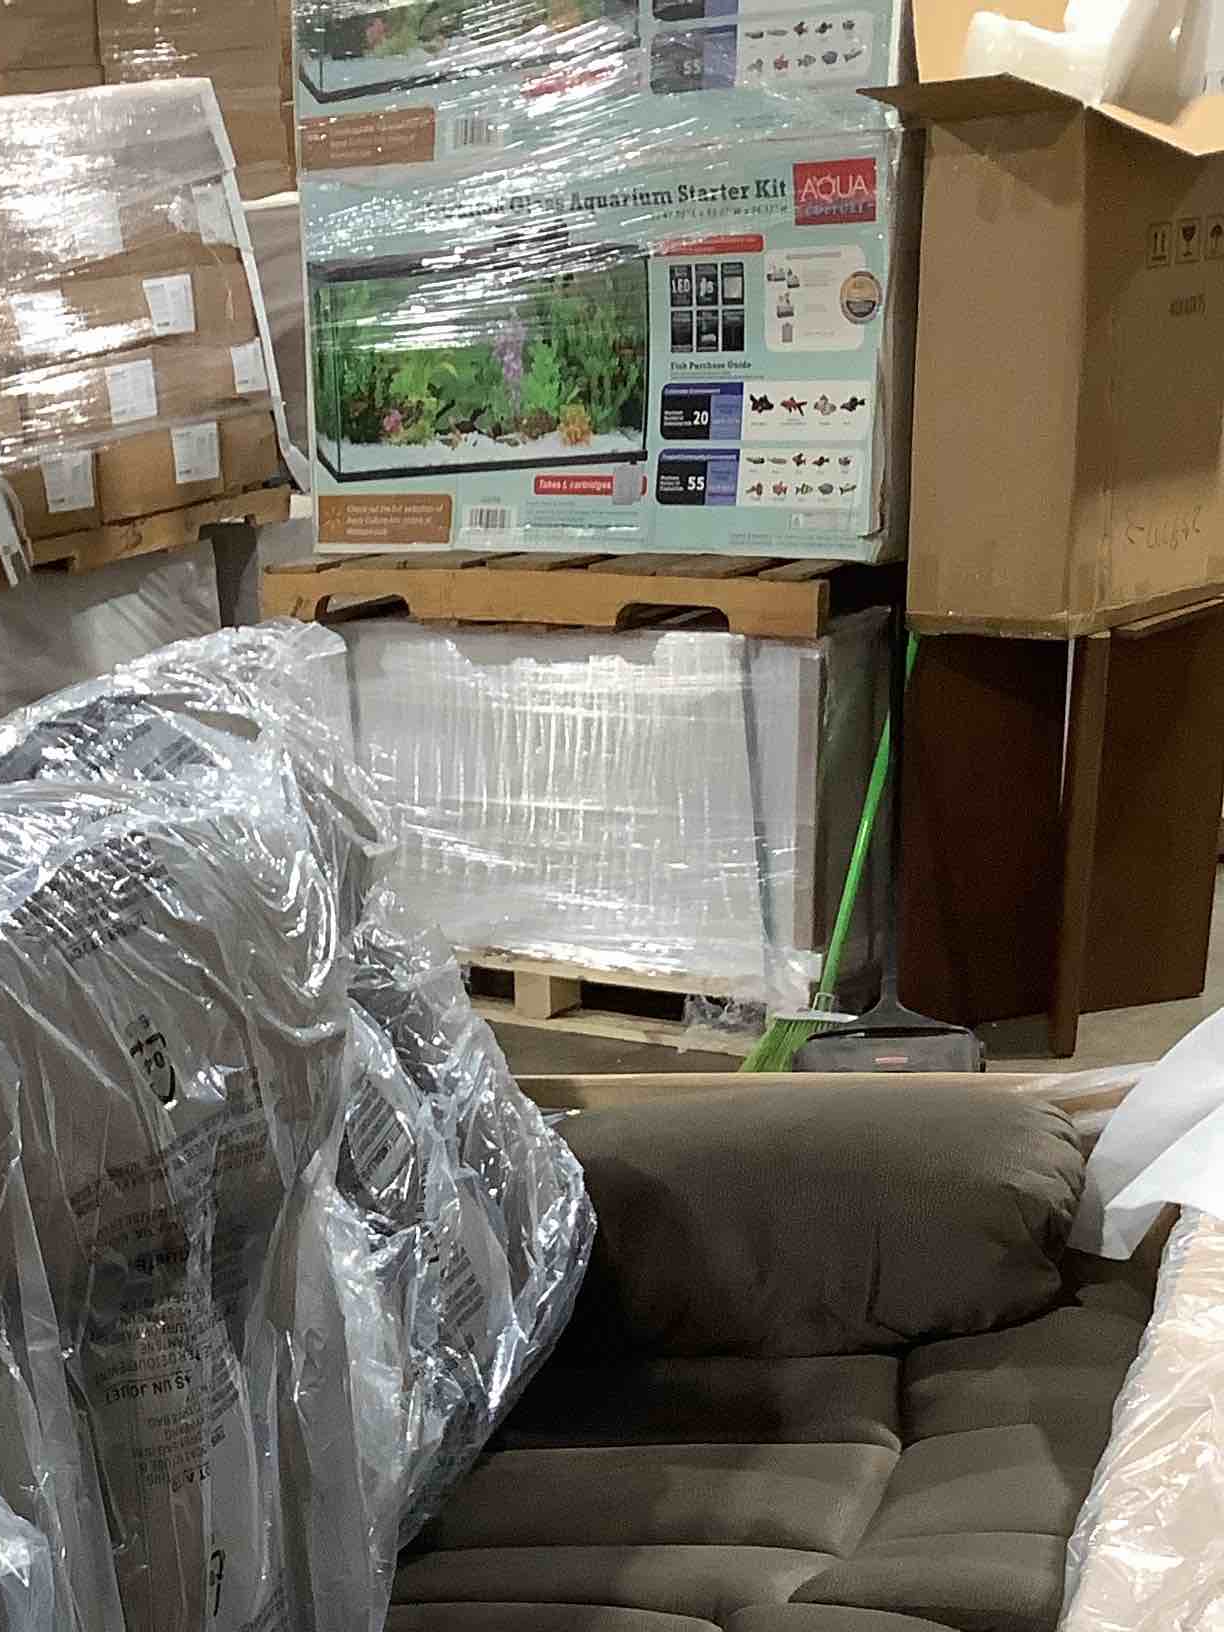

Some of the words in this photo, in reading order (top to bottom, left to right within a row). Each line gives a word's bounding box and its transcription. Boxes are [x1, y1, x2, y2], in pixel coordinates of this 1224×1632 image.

[570, 188, 673, 211] Aquarium
[678, 182, 749, 204] Starter
[756, 178, 786, 199] Kit
[799, 171, 869, 202] AQUA
[693, 410, 709, 426] 20
[687, 475, 705, 492] 55
